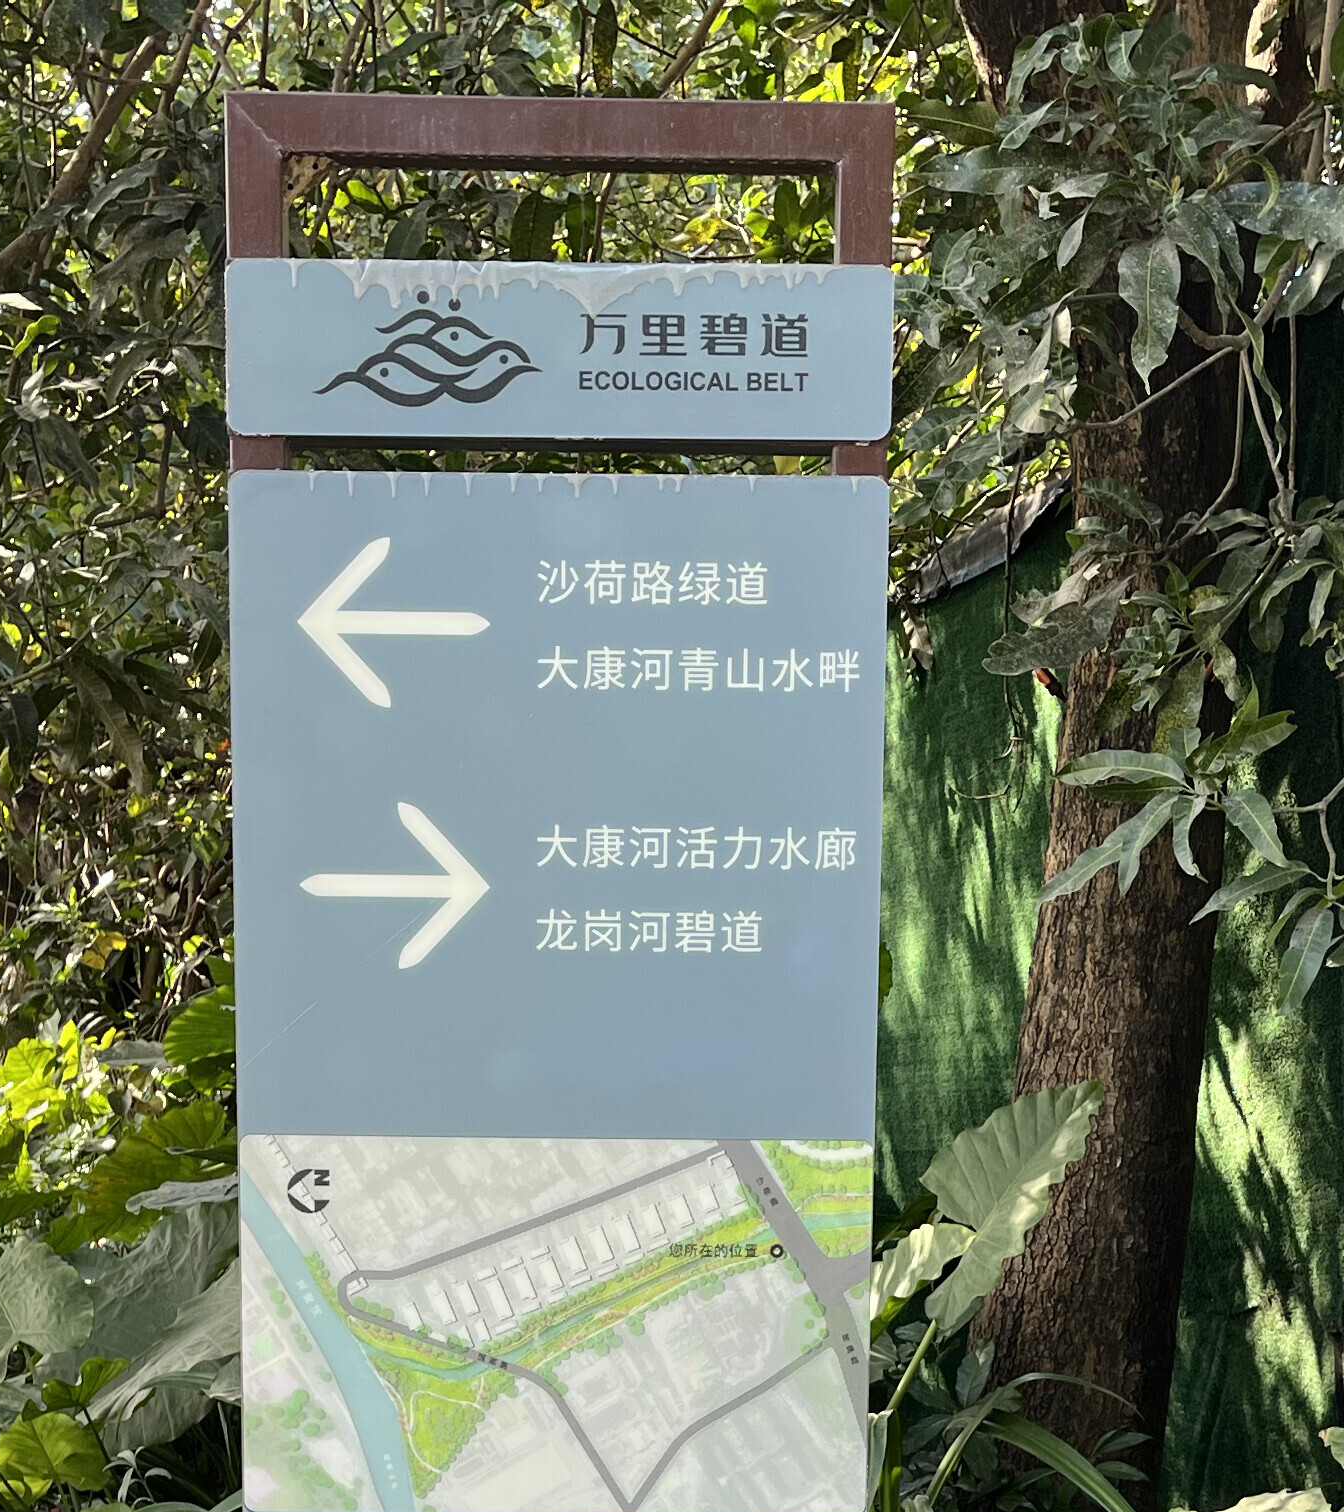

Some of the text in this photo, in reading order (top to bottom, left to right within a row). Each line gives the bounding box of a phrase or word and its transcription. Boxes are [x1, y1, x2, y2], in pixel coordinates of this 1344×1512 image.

[579, 312, 809, 358] 万里碧道
[578, 370, 810, 392] ECOLOGICAL BELT
[537, 559, 769, 606] 沙荷路绿道
[536, 645, 861, 693] 大康河青山水畔
[536, 824, 857, 871] 大康河活力水廊
[535, 908, 764, 953] 龙岗河碧道
[668, 1243, 759, 1259] 您所在的位置
